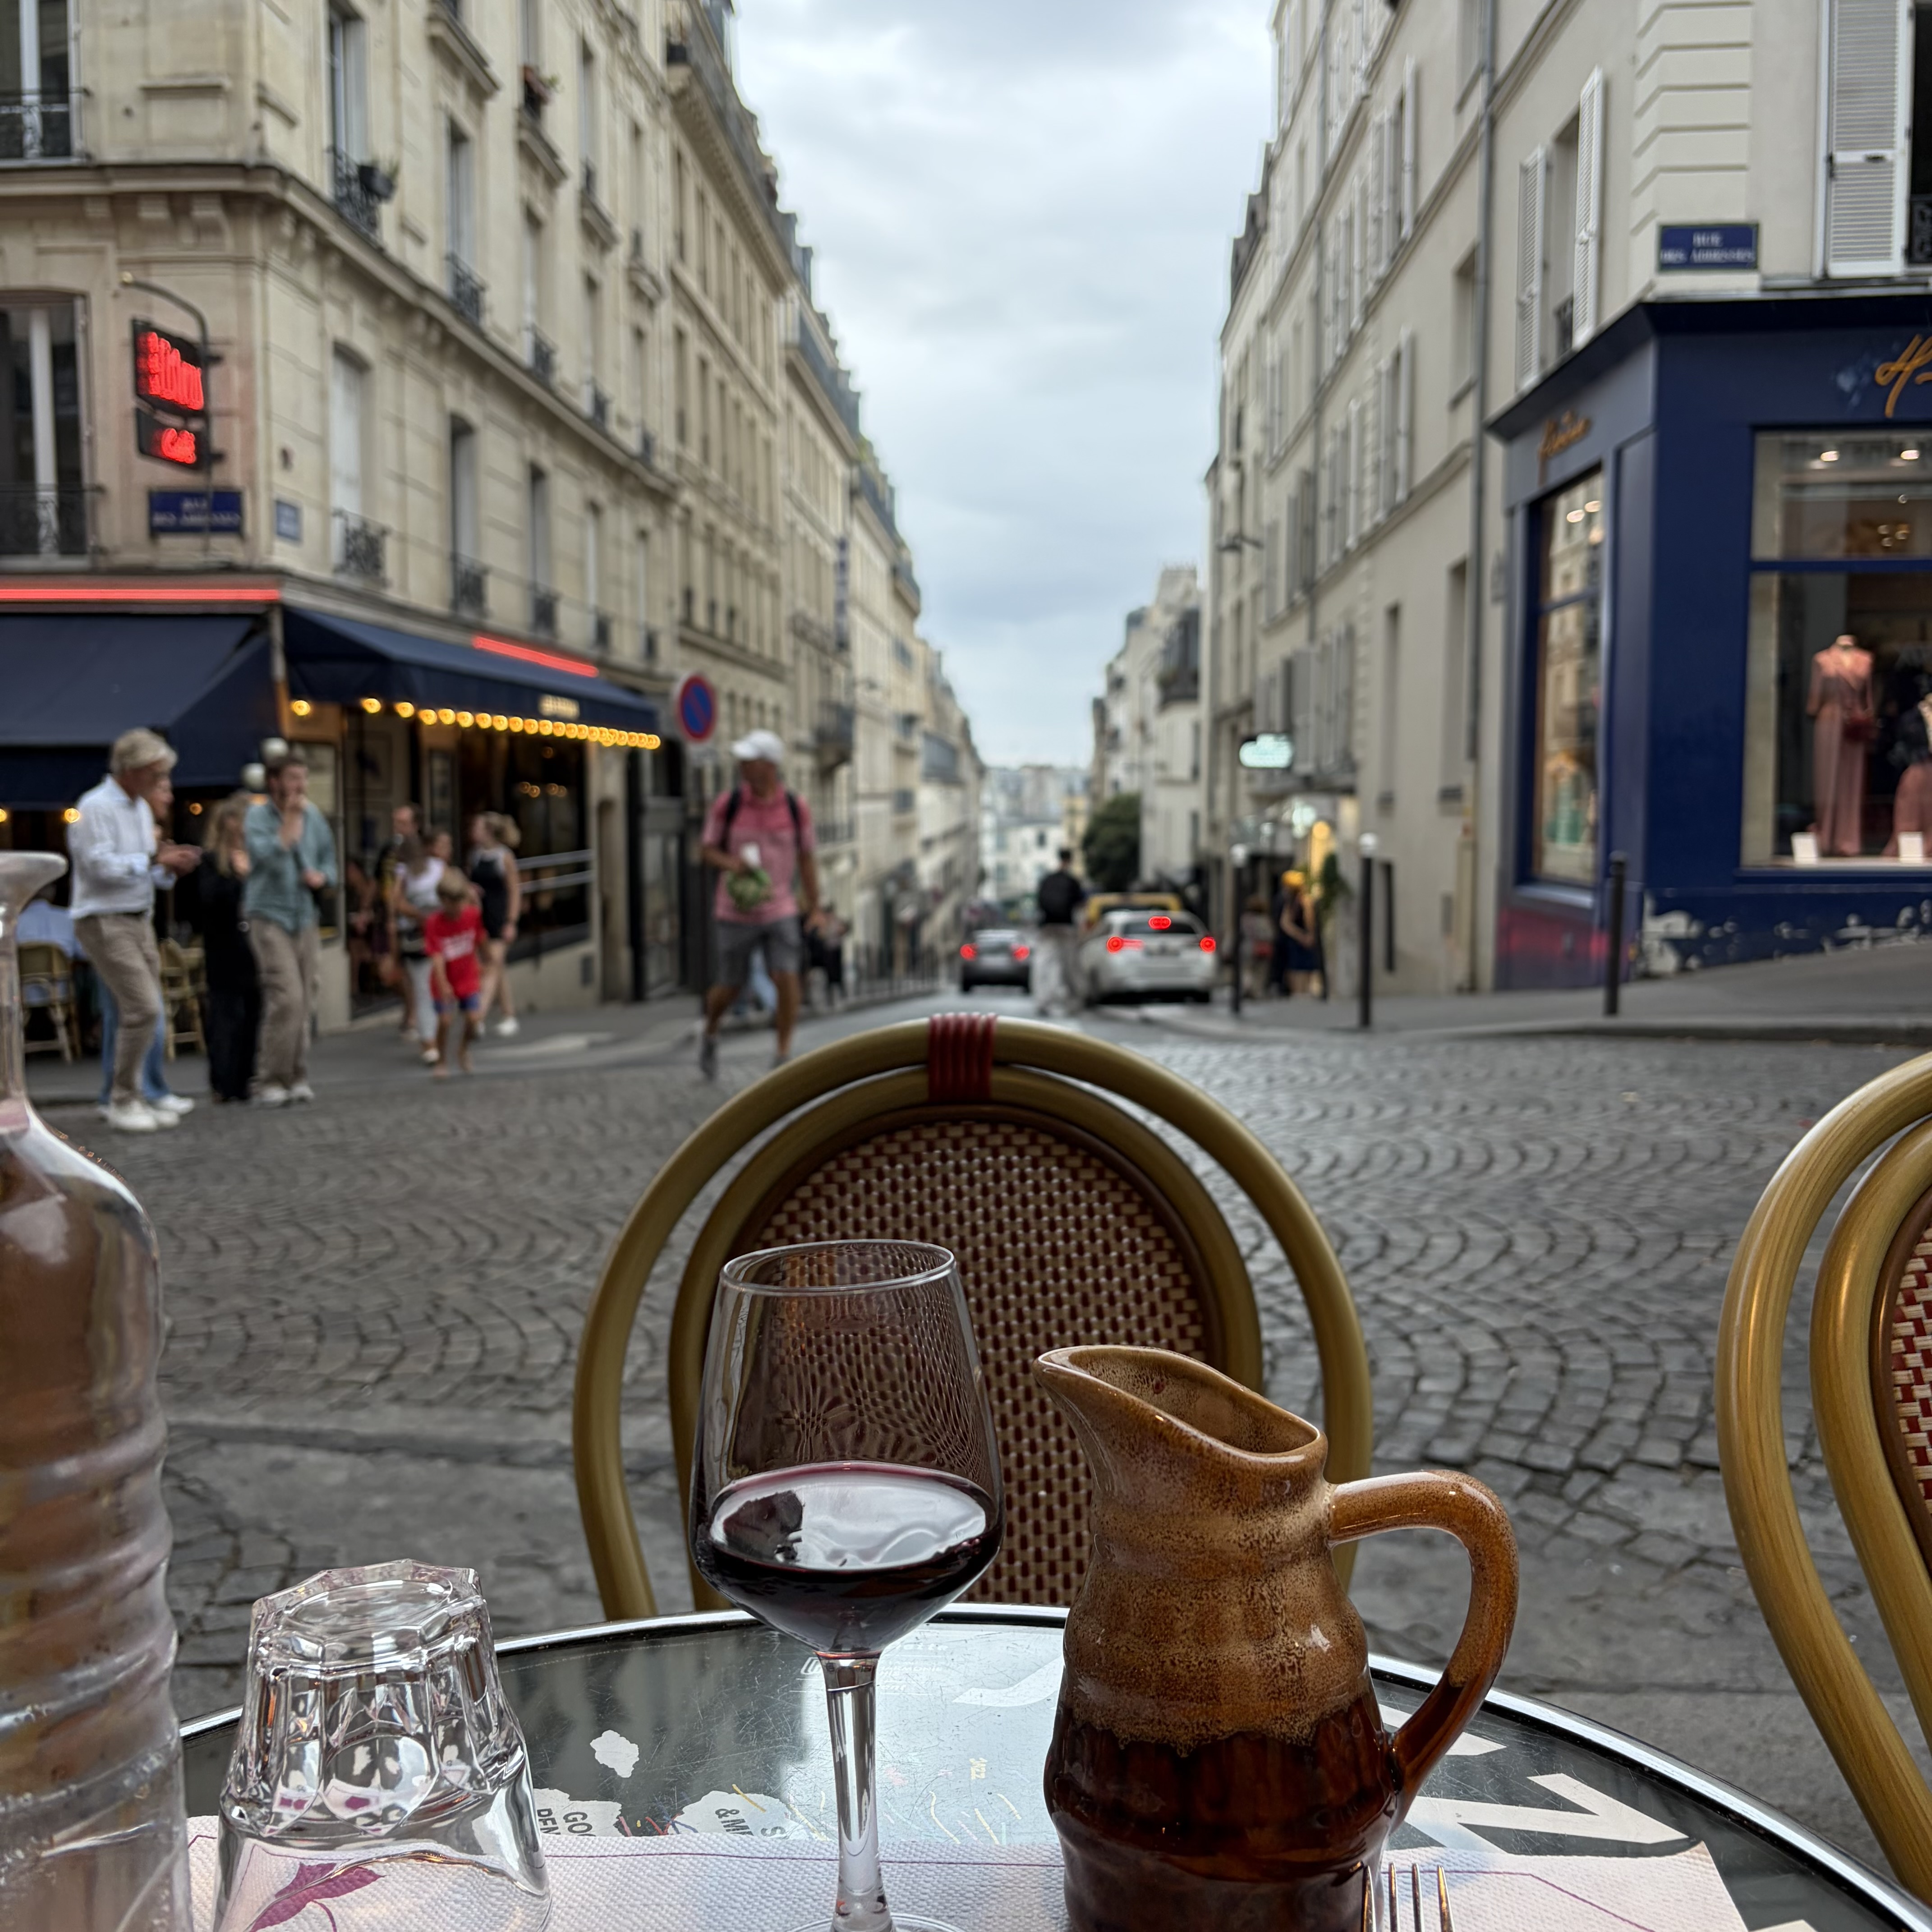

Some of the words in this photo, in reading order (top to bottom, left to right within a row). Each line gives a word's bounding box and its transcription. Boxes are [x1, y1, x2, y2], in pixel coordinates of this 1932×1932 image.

[1693, 231, 1723, 248] RUE
[715, 1808, 740, 1819] &
[562, 1811, 597, 1837] GO
